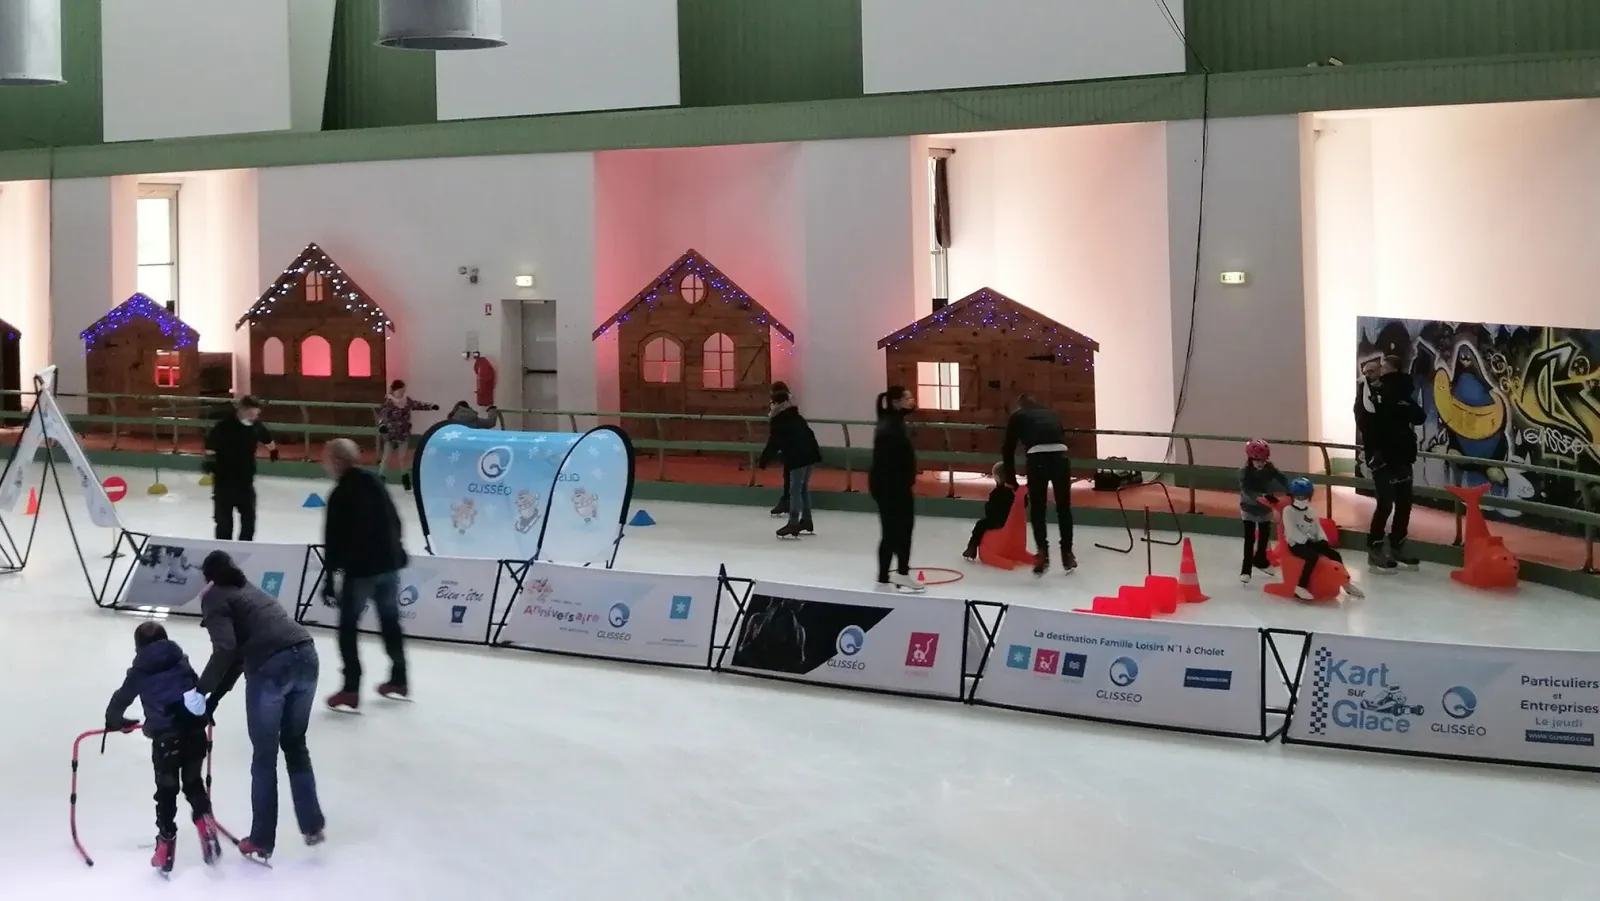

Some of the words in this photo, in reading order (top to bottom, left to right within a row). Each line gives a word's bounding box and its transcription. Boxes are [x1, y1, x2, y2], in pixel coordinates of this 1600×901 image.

[523, 605, 600, 625] Anniversaire
[1034, 630, 1044, 638] La
[1046, 631, 1098, 645] destination
[1099, 637, 1134, 649] Famille
[1135, 641, 1165, 652] Loisirs
[1185, 645, 1192, 654] à
[1193, 646, 1225, 656] Cholet
[1325, 658, 1390, 687] Kart
[1520, 675, 1600, 689] Particuliers
[1347, 688, 1366, 698] sur
[1552, 692, 1562, 700] et
[1520, 699, 1599, 715] Entreprises
[1331, 699, 1411, 734] Glace
[1535, 716, 1549, 726] Le
[1551, 716, 1583, 728] jeudi
